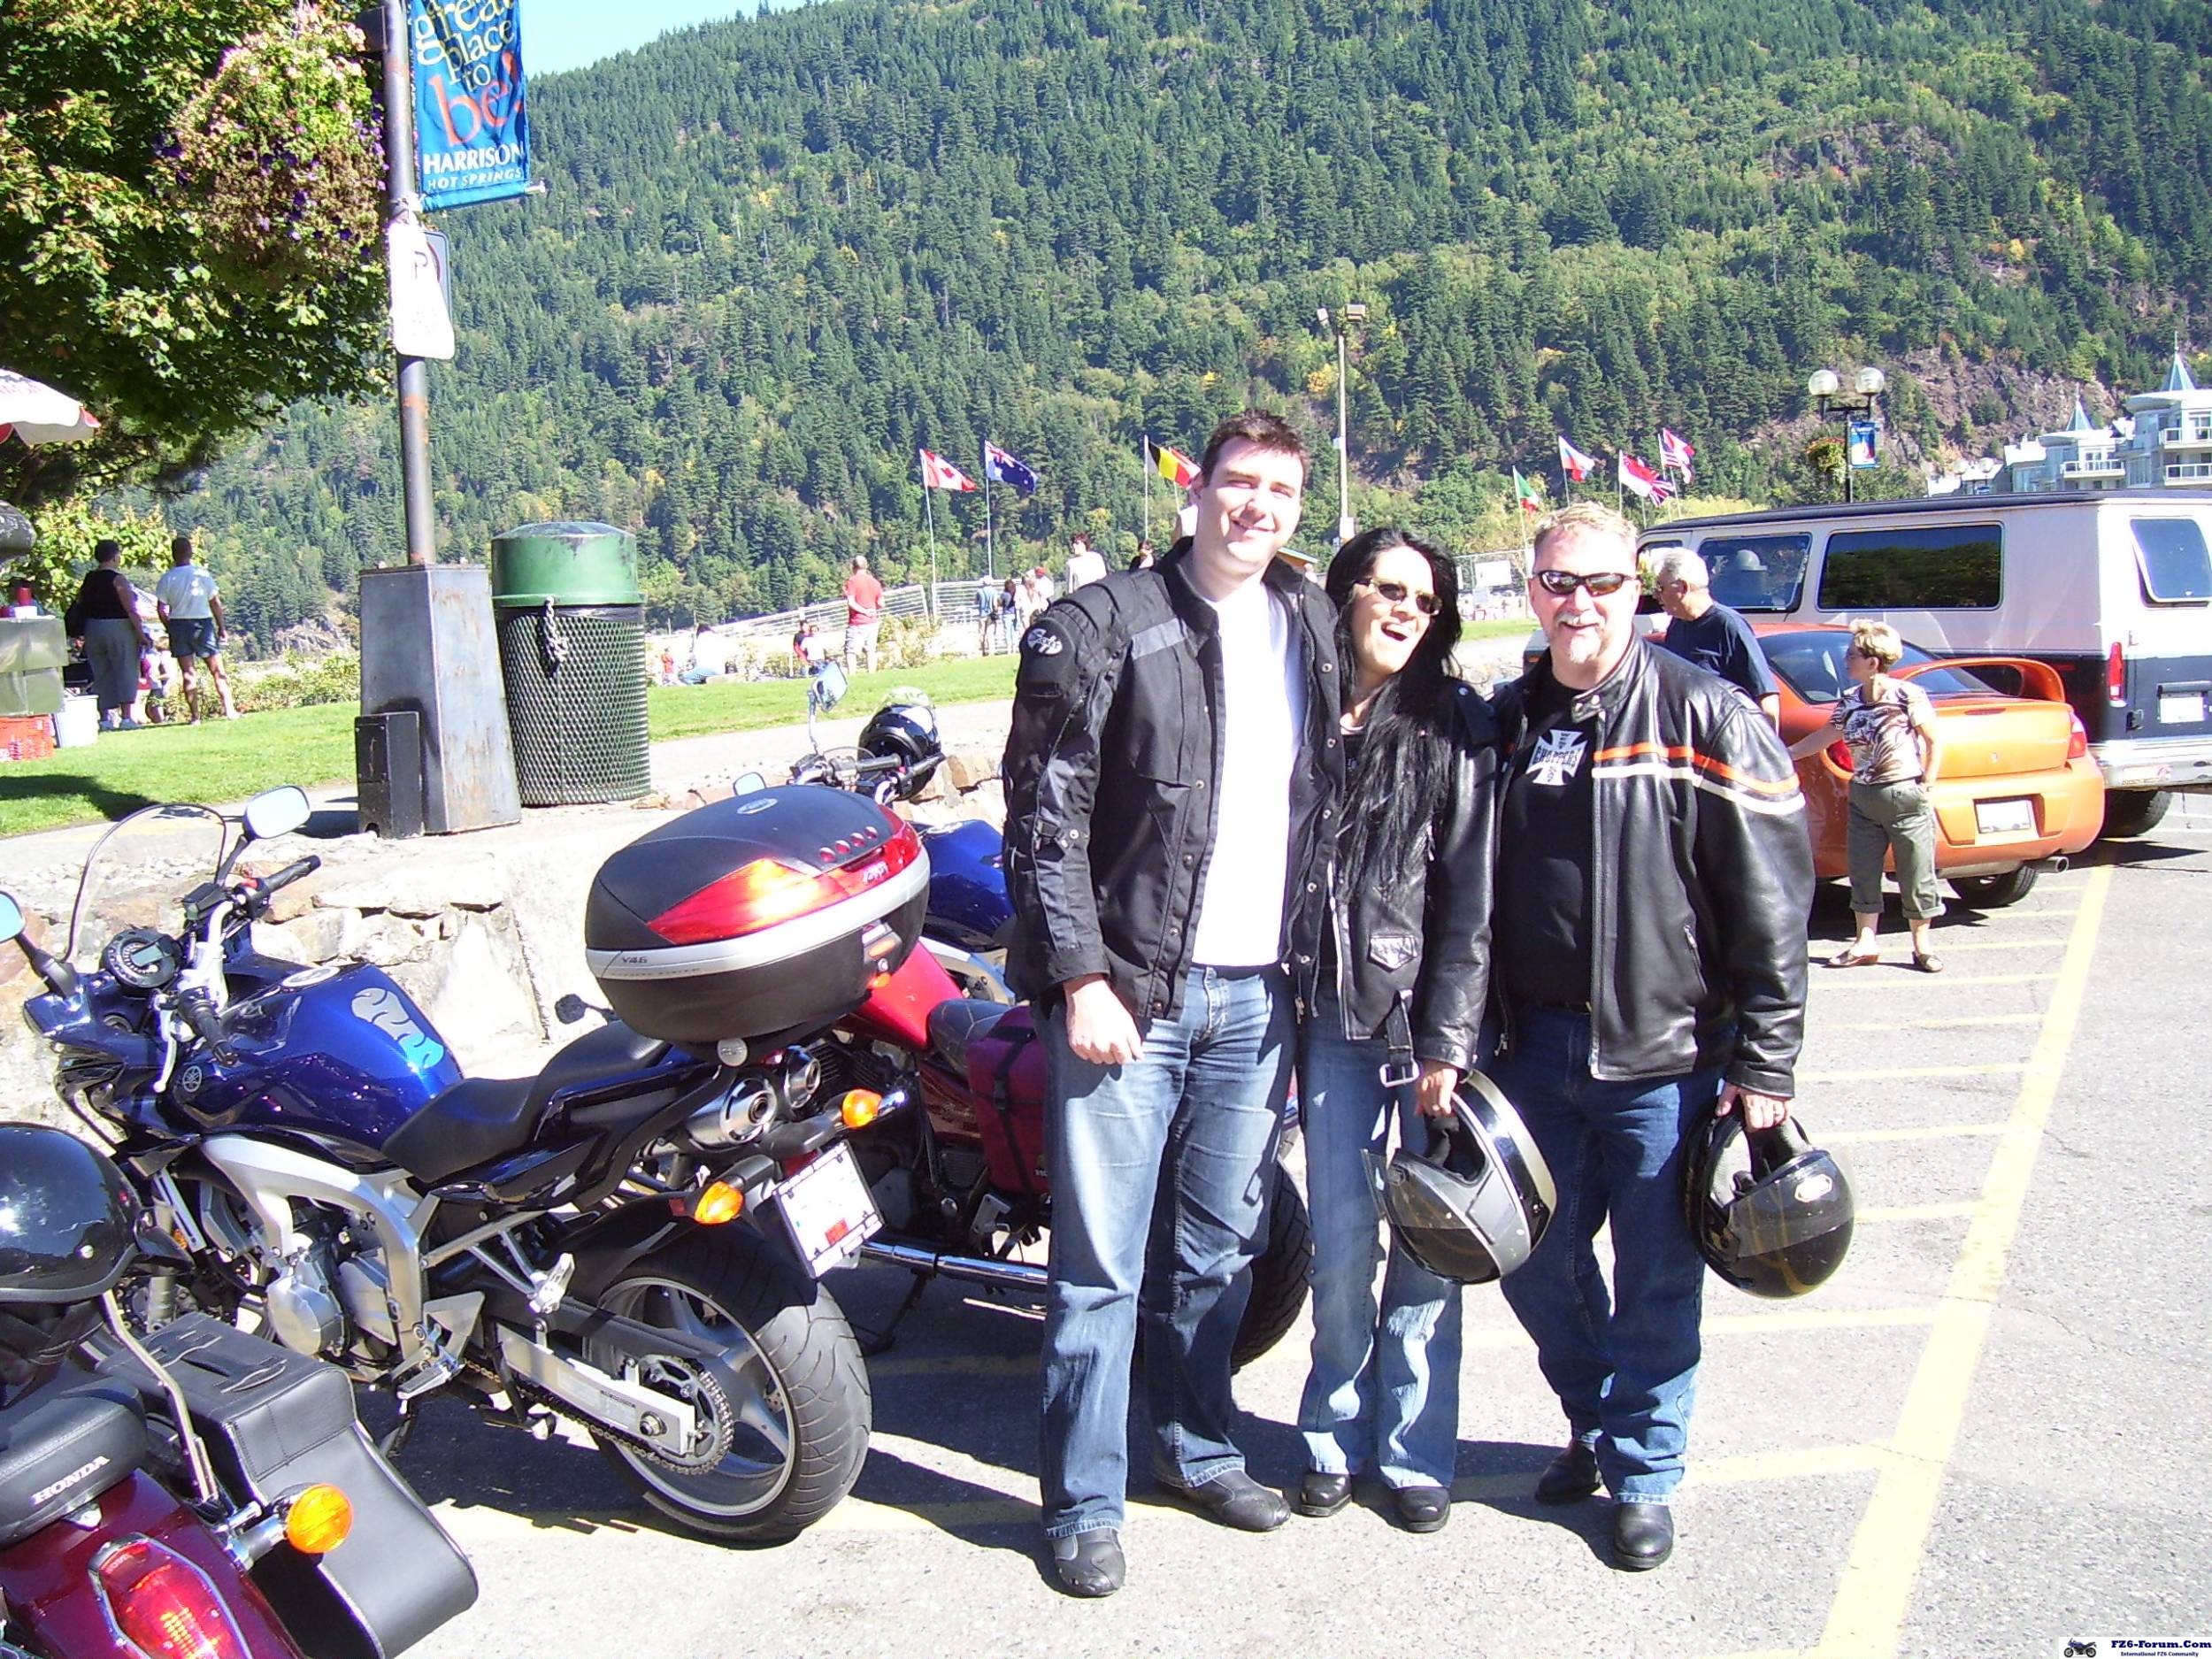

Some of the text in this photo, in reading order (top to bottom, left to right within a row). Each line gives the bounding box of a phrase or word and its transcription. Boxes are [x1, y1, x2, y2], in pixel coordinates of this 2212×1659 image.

[414, 0, 514, 65] grea
[442, 20, 515, 85] place
[463, 63, 492, 92] to
[423, 141, 526, 175] HARRISON
[427, 167, 522, 191] HOT SPRINGS
[30, 1455, 111, 1506] HONDA
